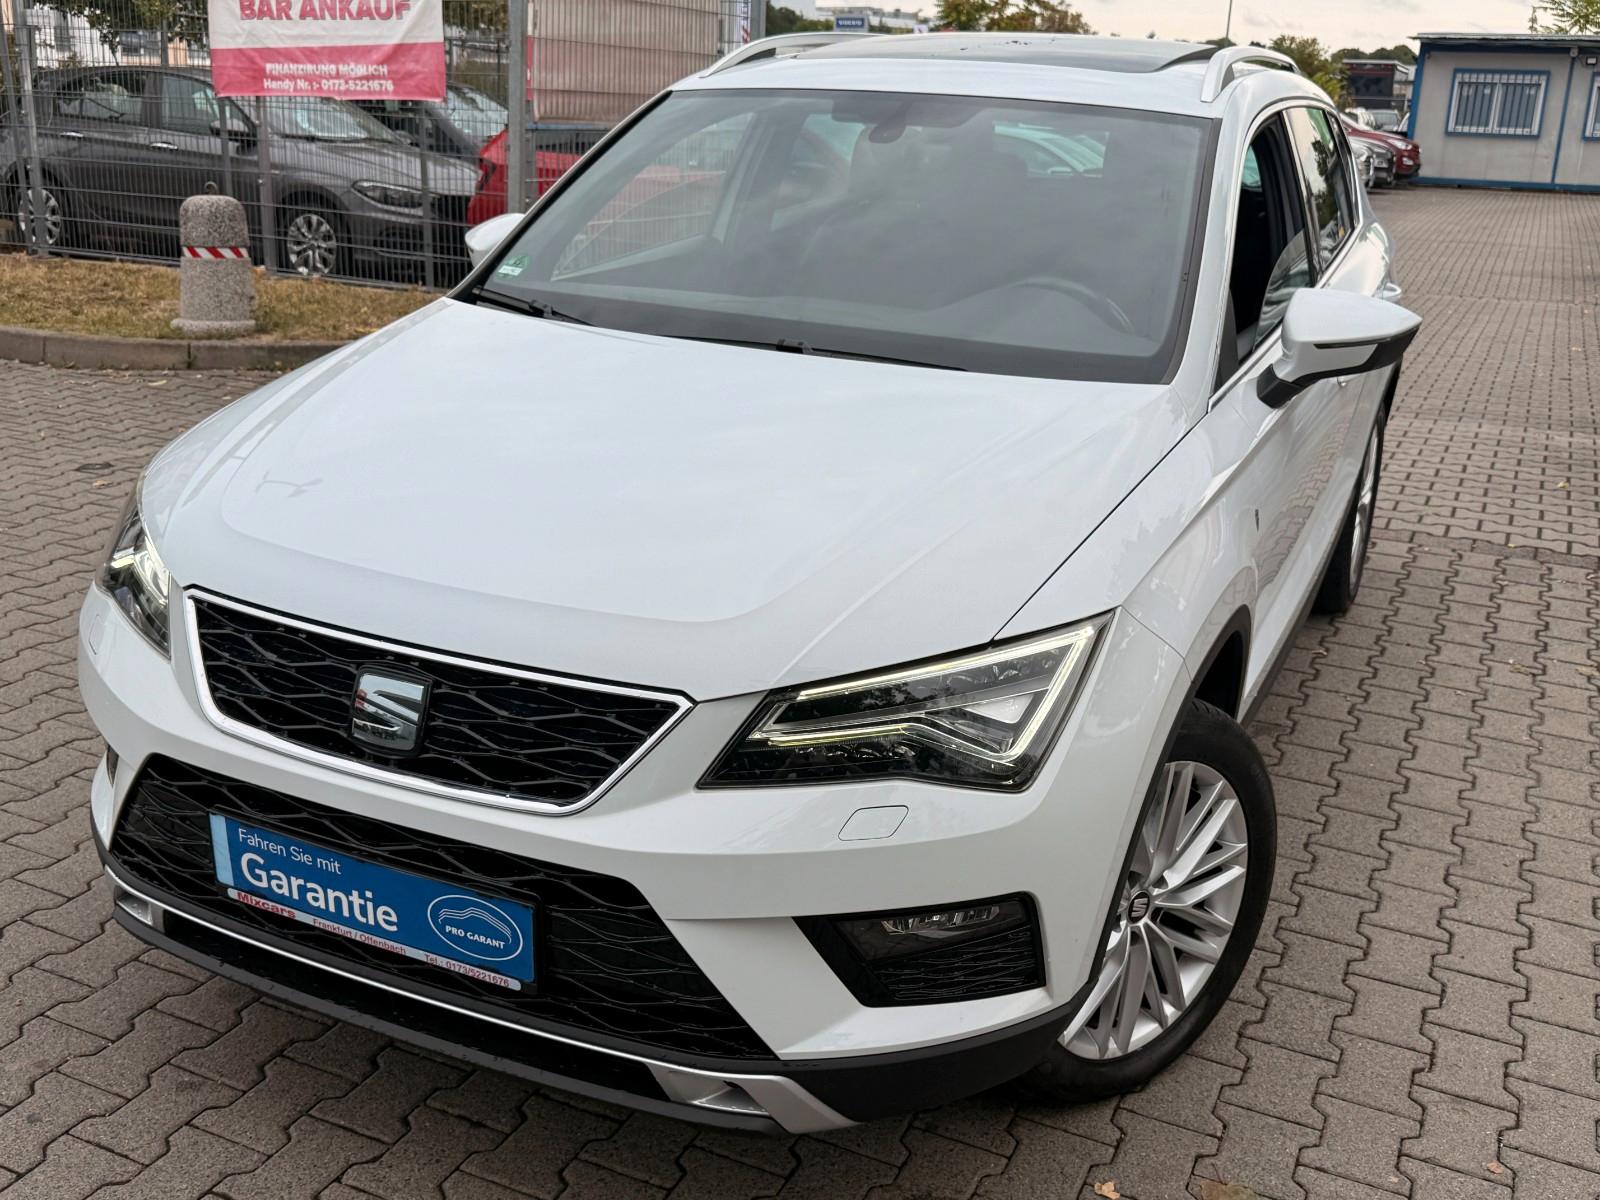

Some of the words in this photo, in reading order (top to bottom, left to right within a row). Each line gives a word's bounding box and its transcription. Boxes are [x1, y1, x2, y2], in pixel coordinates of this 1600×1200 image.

[239, 0, 293, 20] BAR
[299, 0, 411, 20] ANKAUF
[263, 78, 295, 93] Handy
[238, 828, 287, 857] Fahren
[290, 846, 313, 865] Sie
[317, 855, 342, 875] mit
[240, 852, 399, 932] Garantie
[236, 890, 297, 919] Mixcars
[312, 917, 353, 939] Frankfurt
[359, 932, 408, 956] Offenbach
[445, 925, 466, 937] PRO
[466, 931, 506, 950] GARANT
